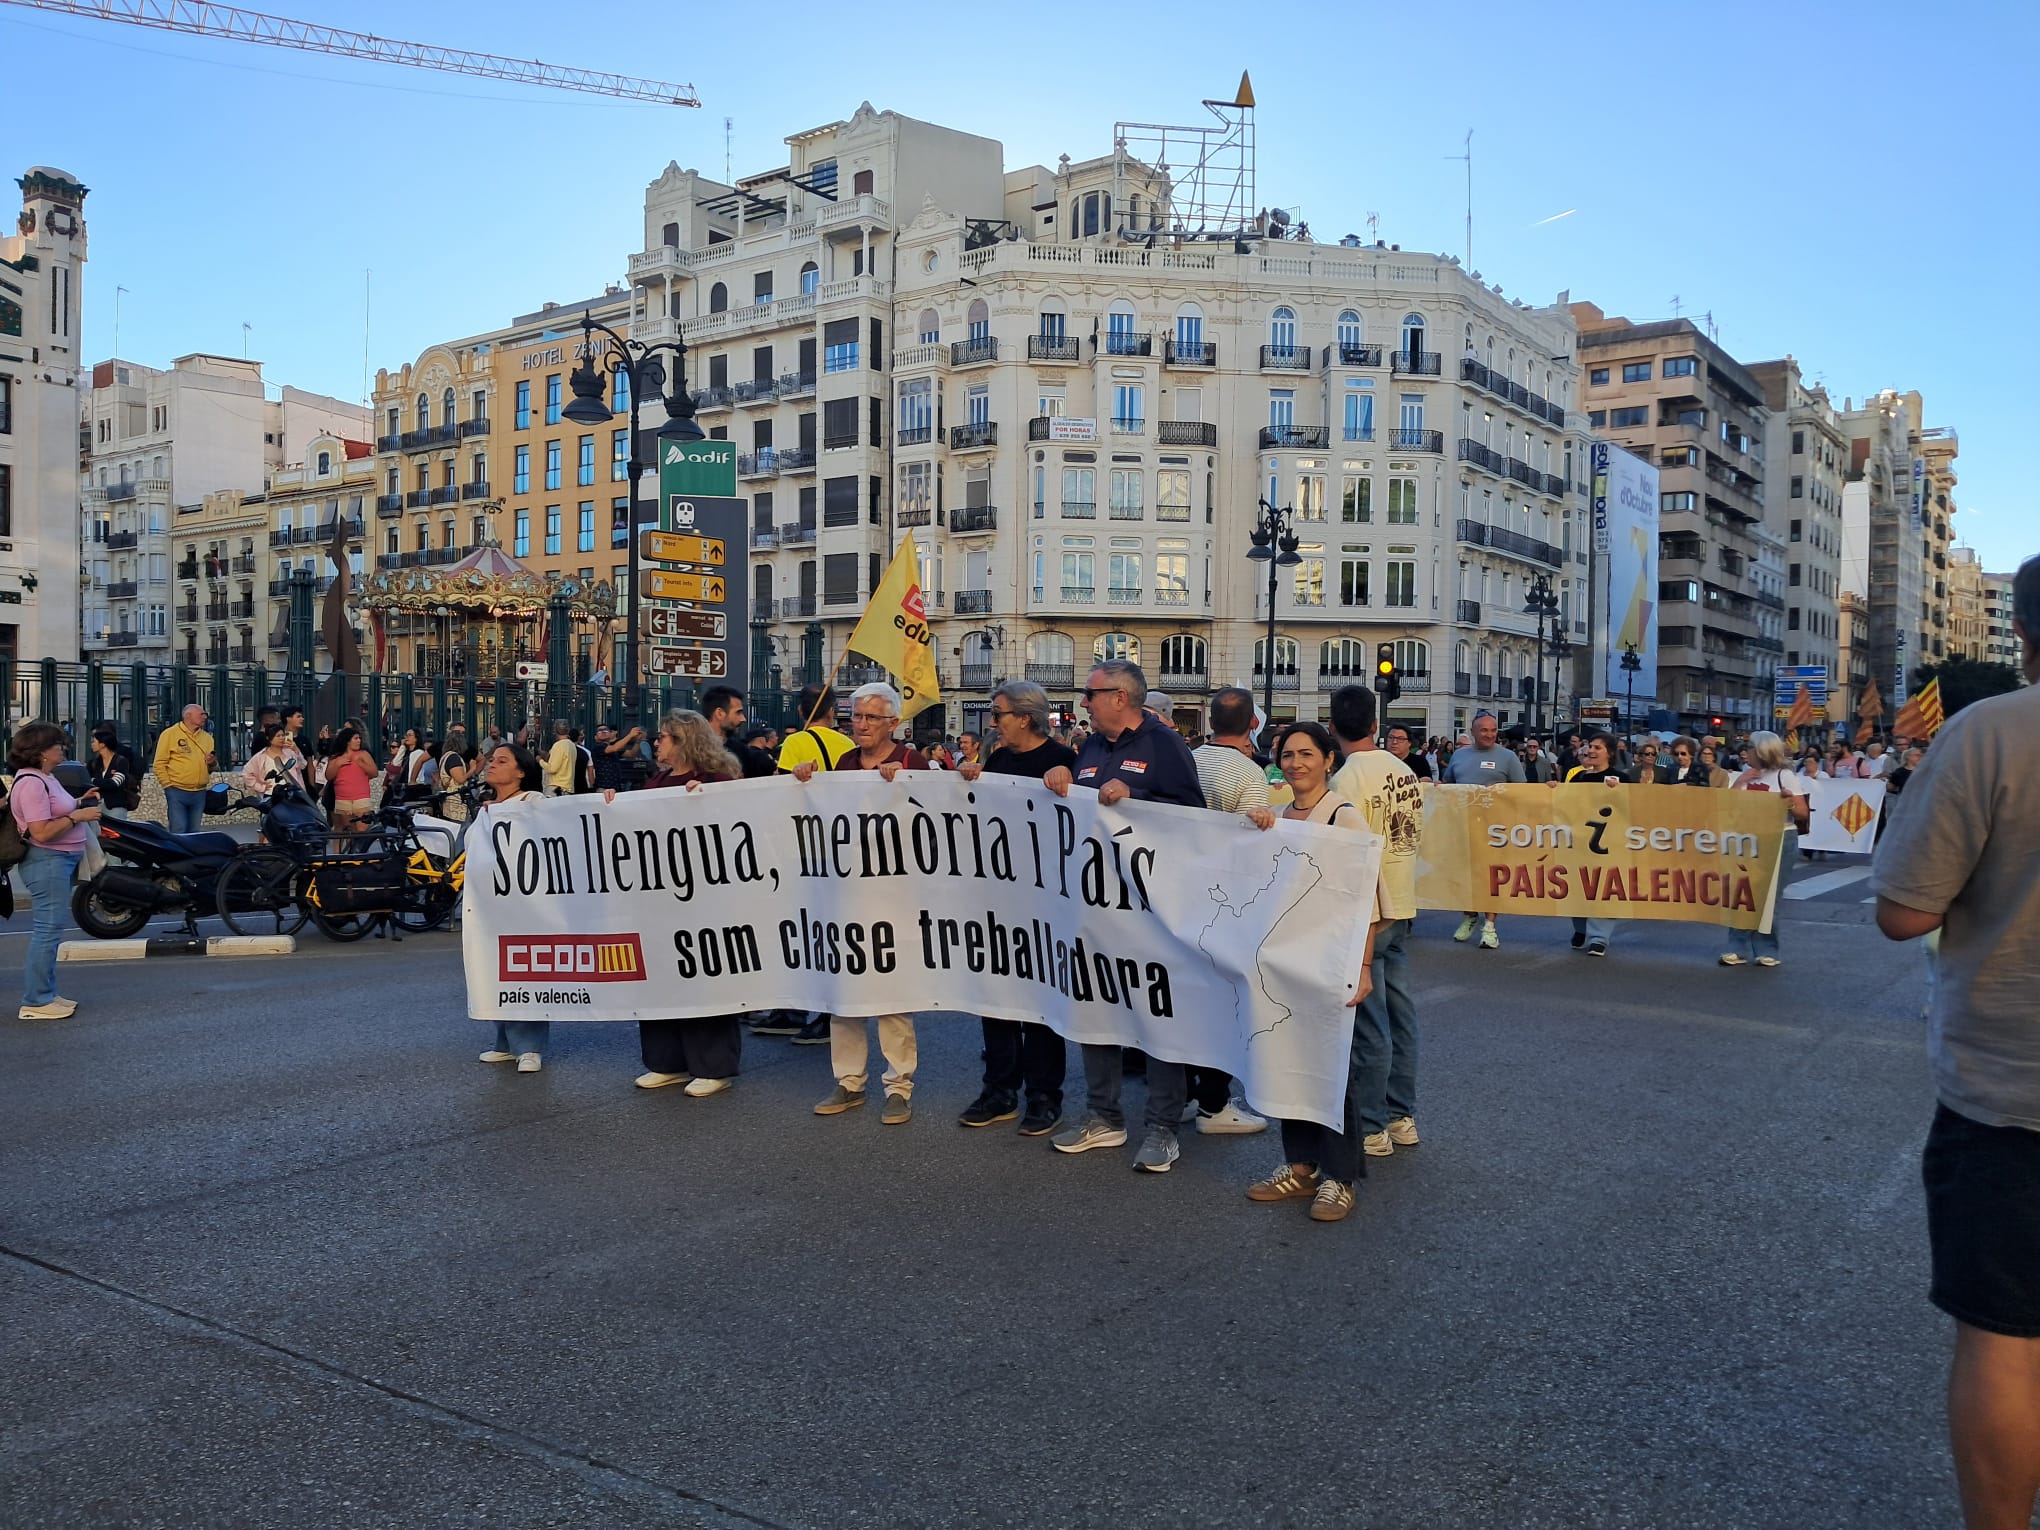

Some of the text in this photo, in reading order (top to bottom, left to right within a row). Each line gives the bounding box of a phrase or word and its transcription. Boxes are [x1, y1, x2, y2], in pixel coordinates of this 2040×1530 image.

[522, 347, 567, 371] HOTEL
[688, 450, 731, 464] adif
[1639, 473, 1654, 497] Nou
[1487, 806, 1759, 859] som i serem
[492, 791, 1156, 913] Som llengua, memòria i País
[1489, 854, 1757, 913] PAÍS VALENCIÀ
[507, 944, 596, 973] CCOO
[674, 907, 1174, 1019] som classe treballadora
[498, 988, 591, 1007] país valencià
